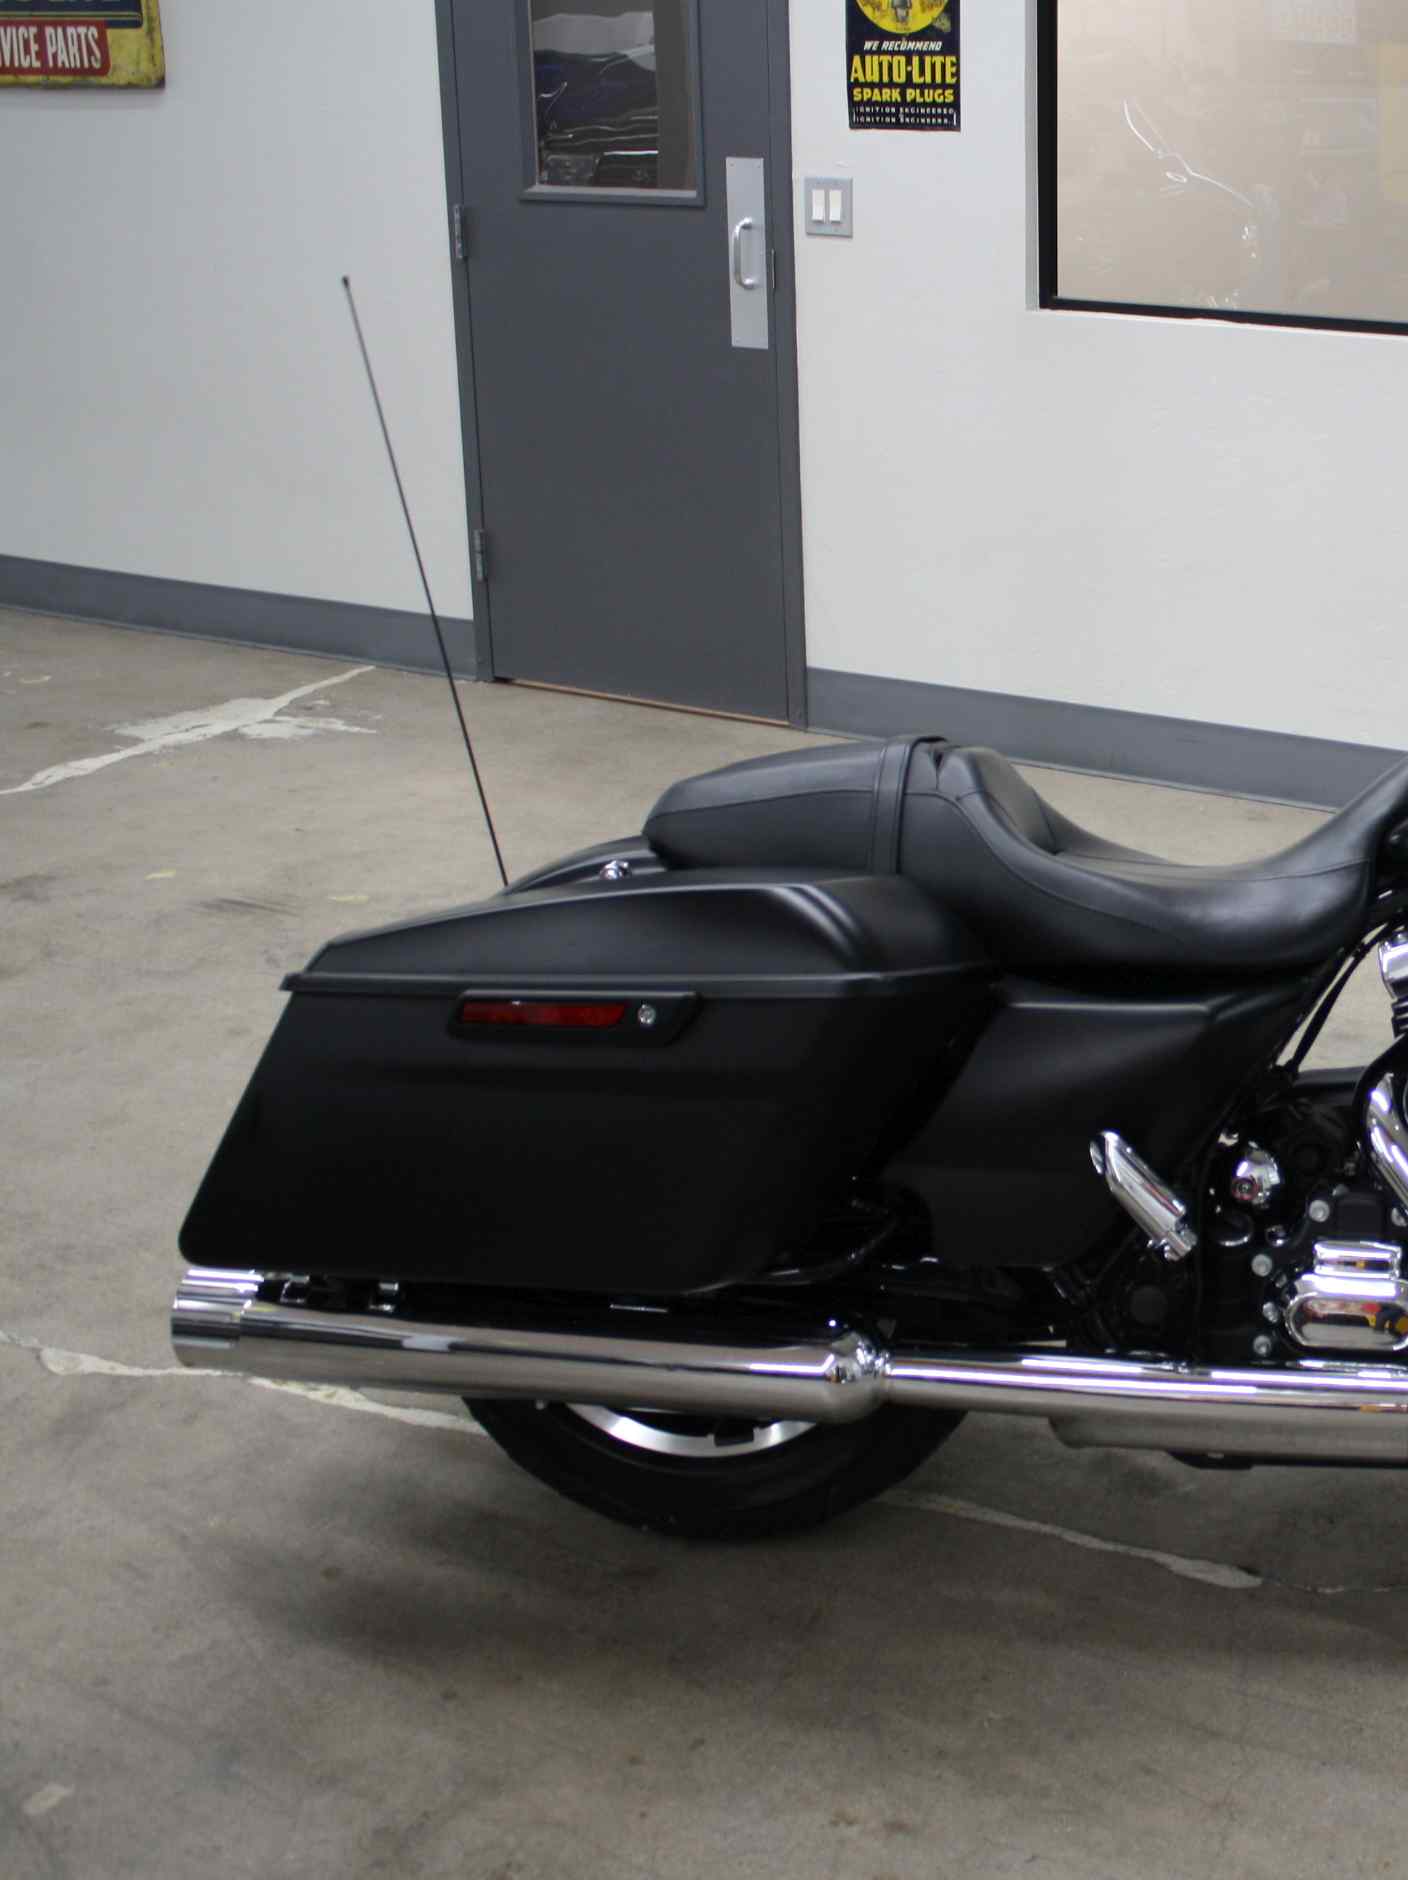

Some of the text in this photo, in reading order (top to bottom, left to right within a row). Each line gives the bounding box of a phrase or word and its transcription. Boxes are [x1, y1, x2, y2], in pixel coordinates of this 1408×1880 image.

[44, 26, 102, 68] PARTS
[863, 40, 943, 51] WE RECOMMEND
[852, 87, 954, 103] SPARK PLUGS
